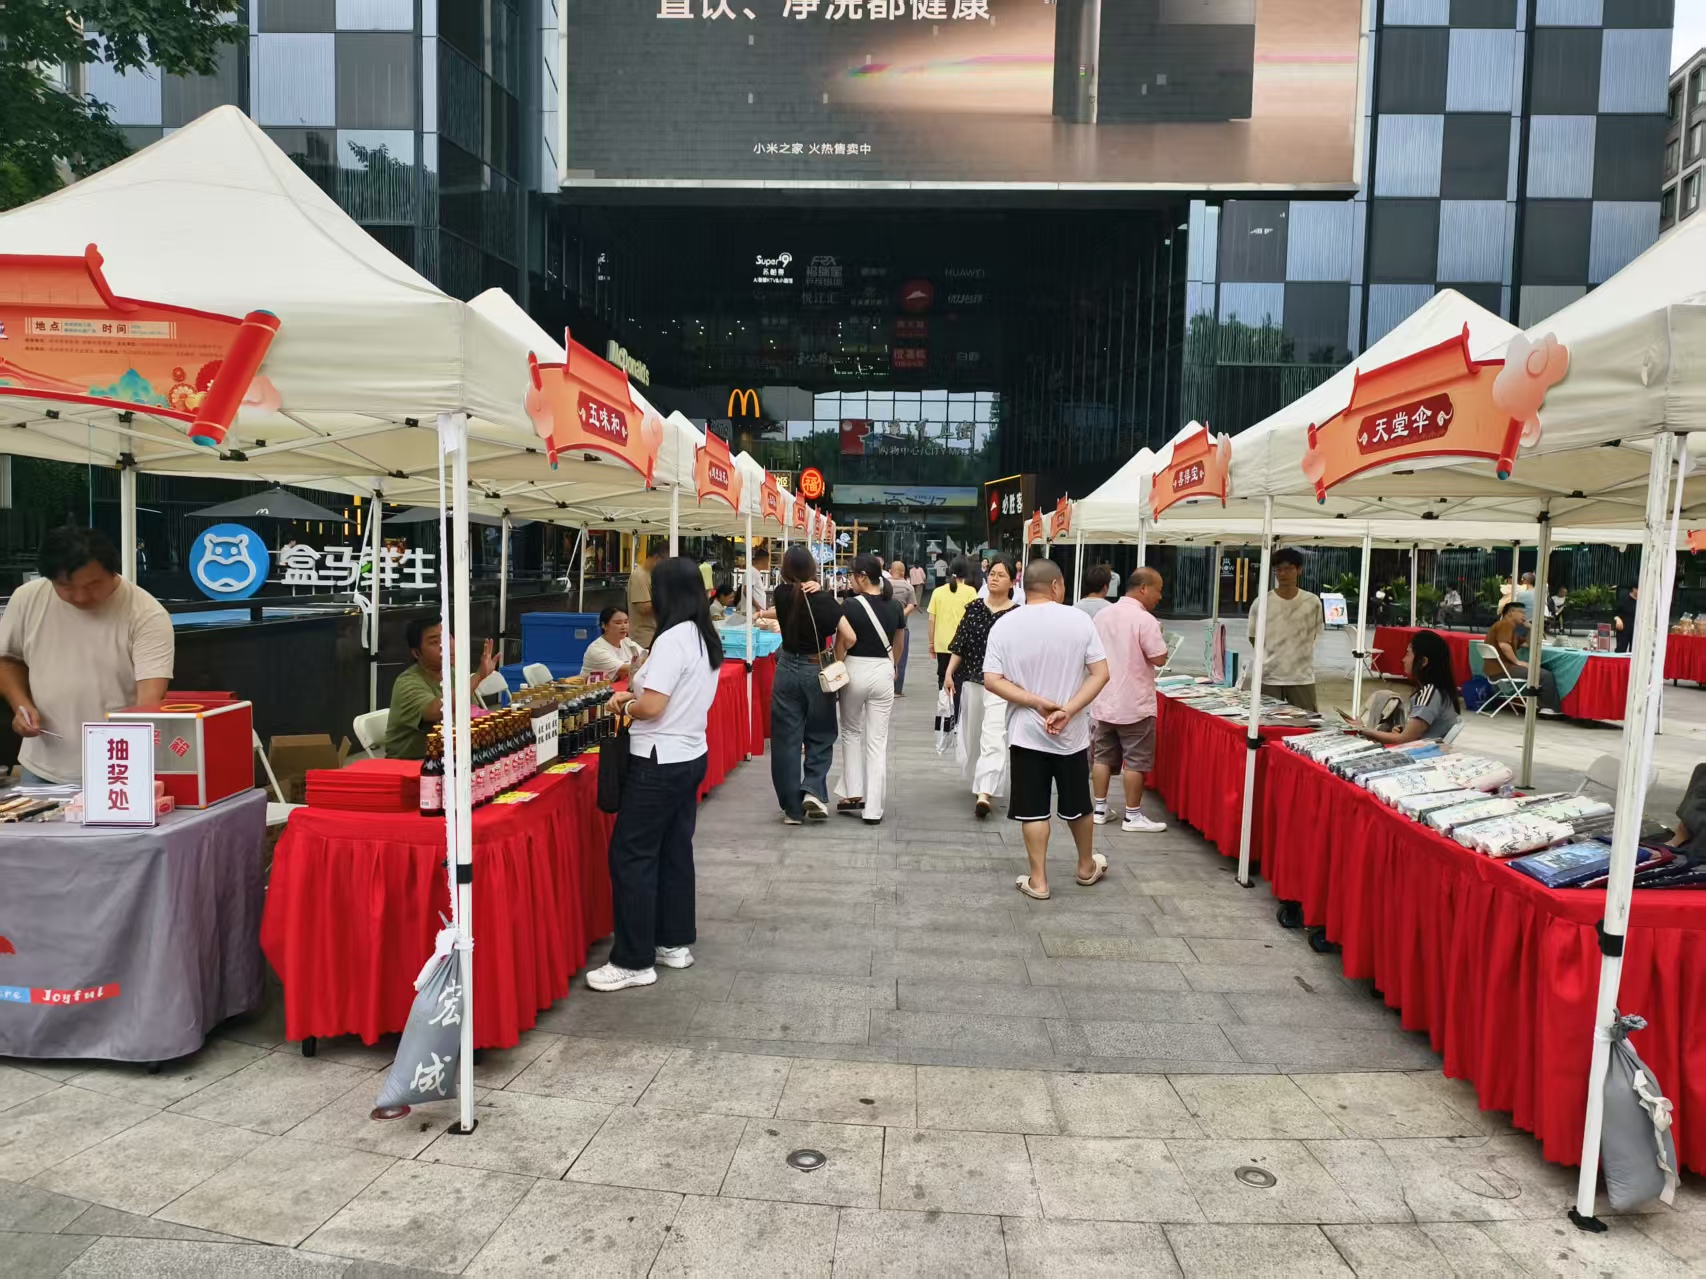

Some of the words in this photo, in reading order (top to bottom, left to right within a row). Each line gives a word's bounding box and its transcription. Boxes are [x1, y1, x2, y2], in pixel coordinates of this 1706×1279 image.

[753, 142, 804, 156] 小米之家
[808, 142, 872, 156] 火热售卖中
[35, 320, 60, 332] 地点
[102, 323, 127, 334] 时间
[588, 402, 621, 435] 五味和
[1372, 404, 1433, 443] 天堂伞
[1001, 492, 1023, 515] 必胜客
[106, 738, 130, 811] 抽奖处
[42, 986, 105, 1004] Joyful
